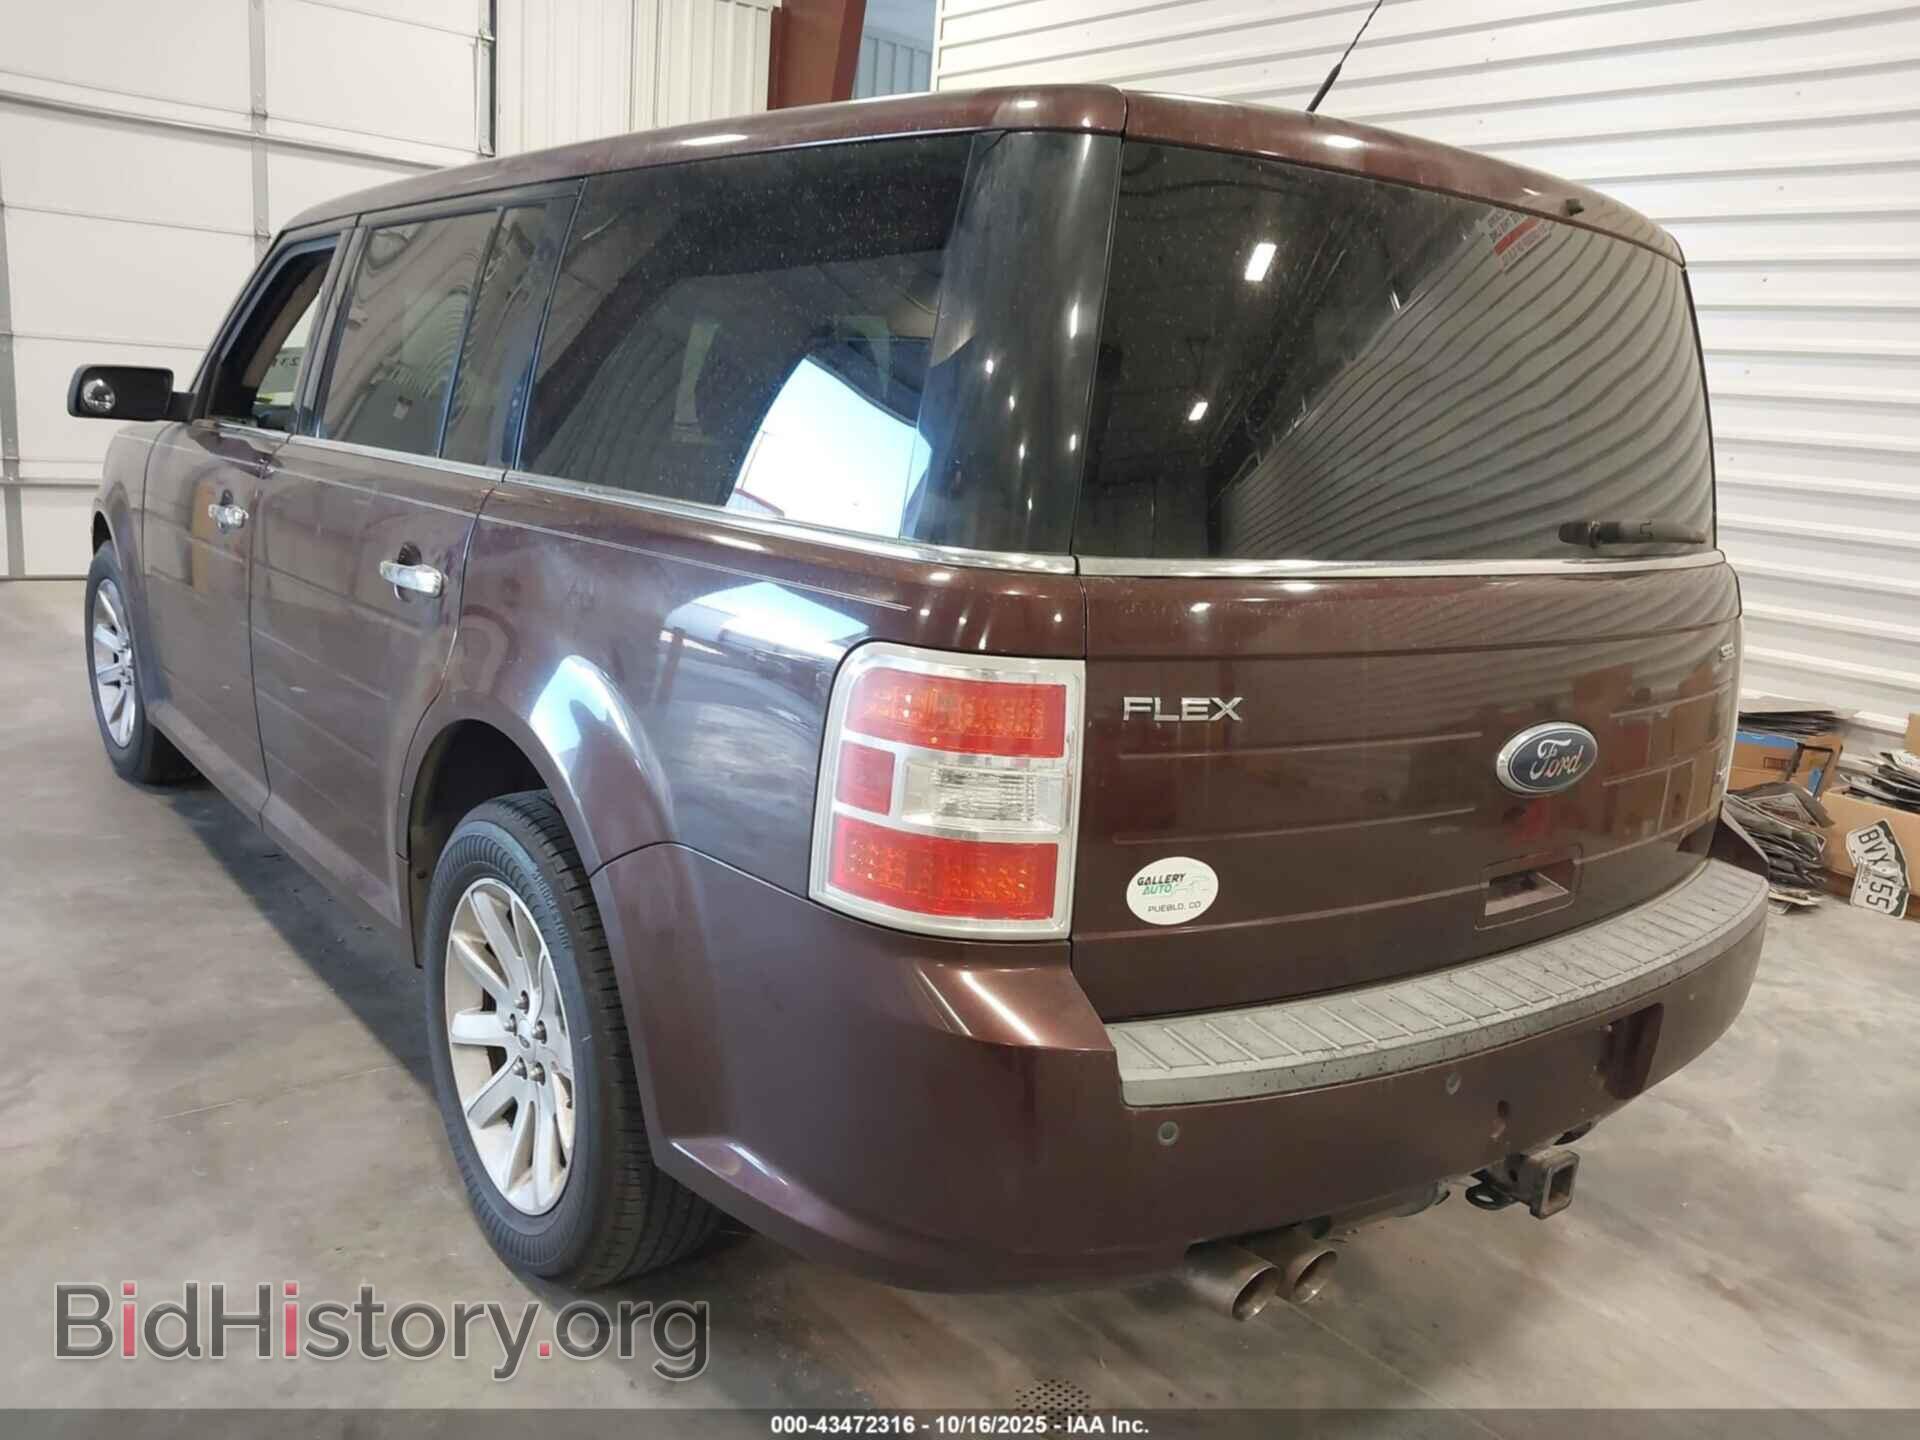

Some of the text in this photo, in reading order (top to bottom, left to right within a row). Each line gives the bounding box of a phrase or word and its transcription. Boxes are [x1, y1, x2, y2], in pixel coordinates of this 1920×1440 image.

[1123, 696, 1243, 721] FLEX
[1529, 738, 1585, 780] Ford
[1858, 828, 1892, 867] BVX
[1141, 884, 1173, 896] AUTO
[1188, 900, 1202, 910] CO
